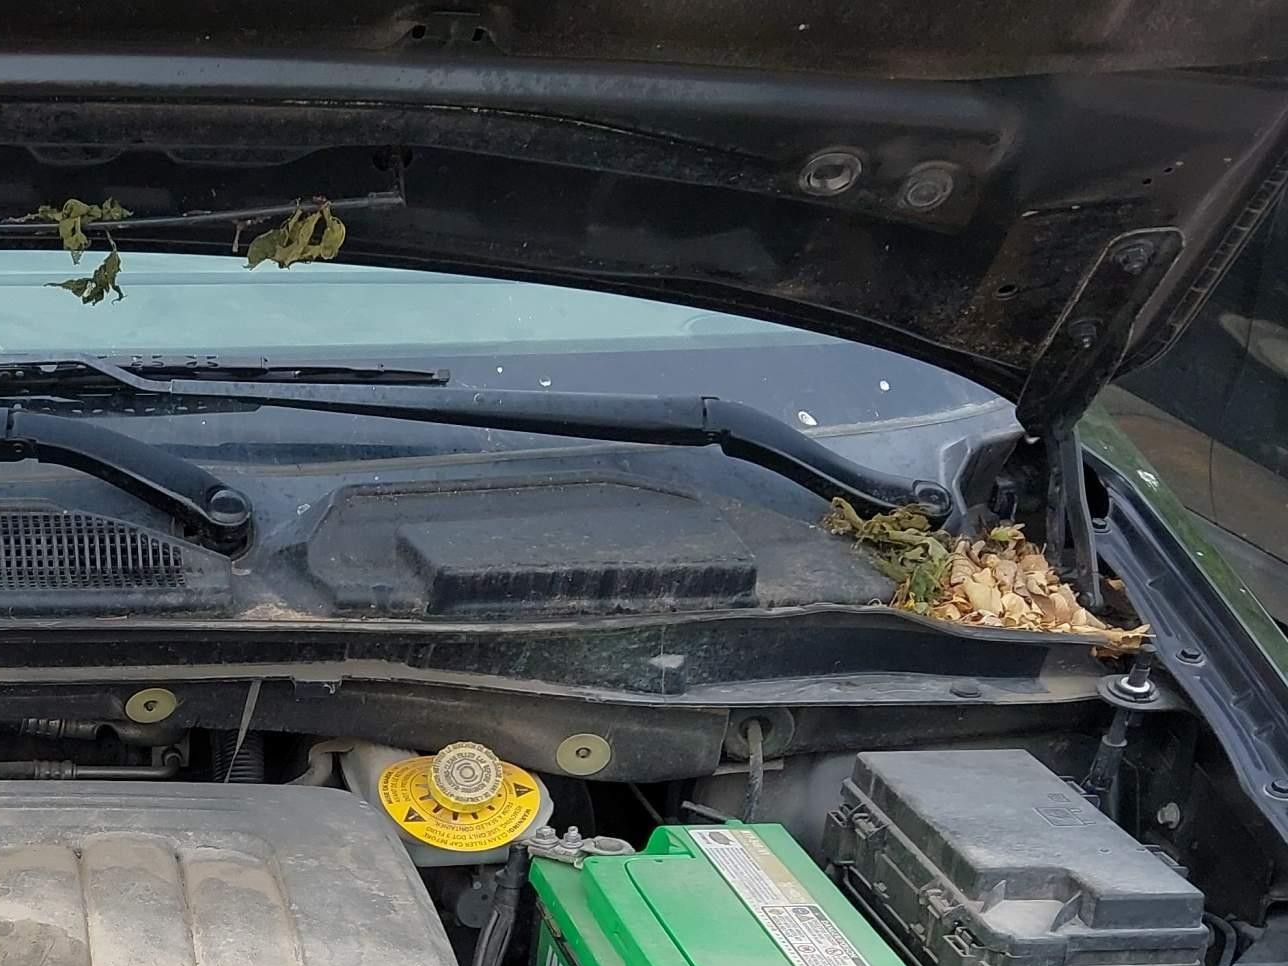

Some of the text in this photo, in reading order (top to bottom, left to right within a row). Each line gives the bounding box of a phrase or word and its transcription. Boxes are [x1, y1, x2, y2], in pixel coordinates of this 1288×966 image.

[468, 832, 486, 840] ONLY
[486, 830, 508, 844] CLEAN
[449, 840, 464, 848] CAP
[464, 839, 488, 848] FILLER
